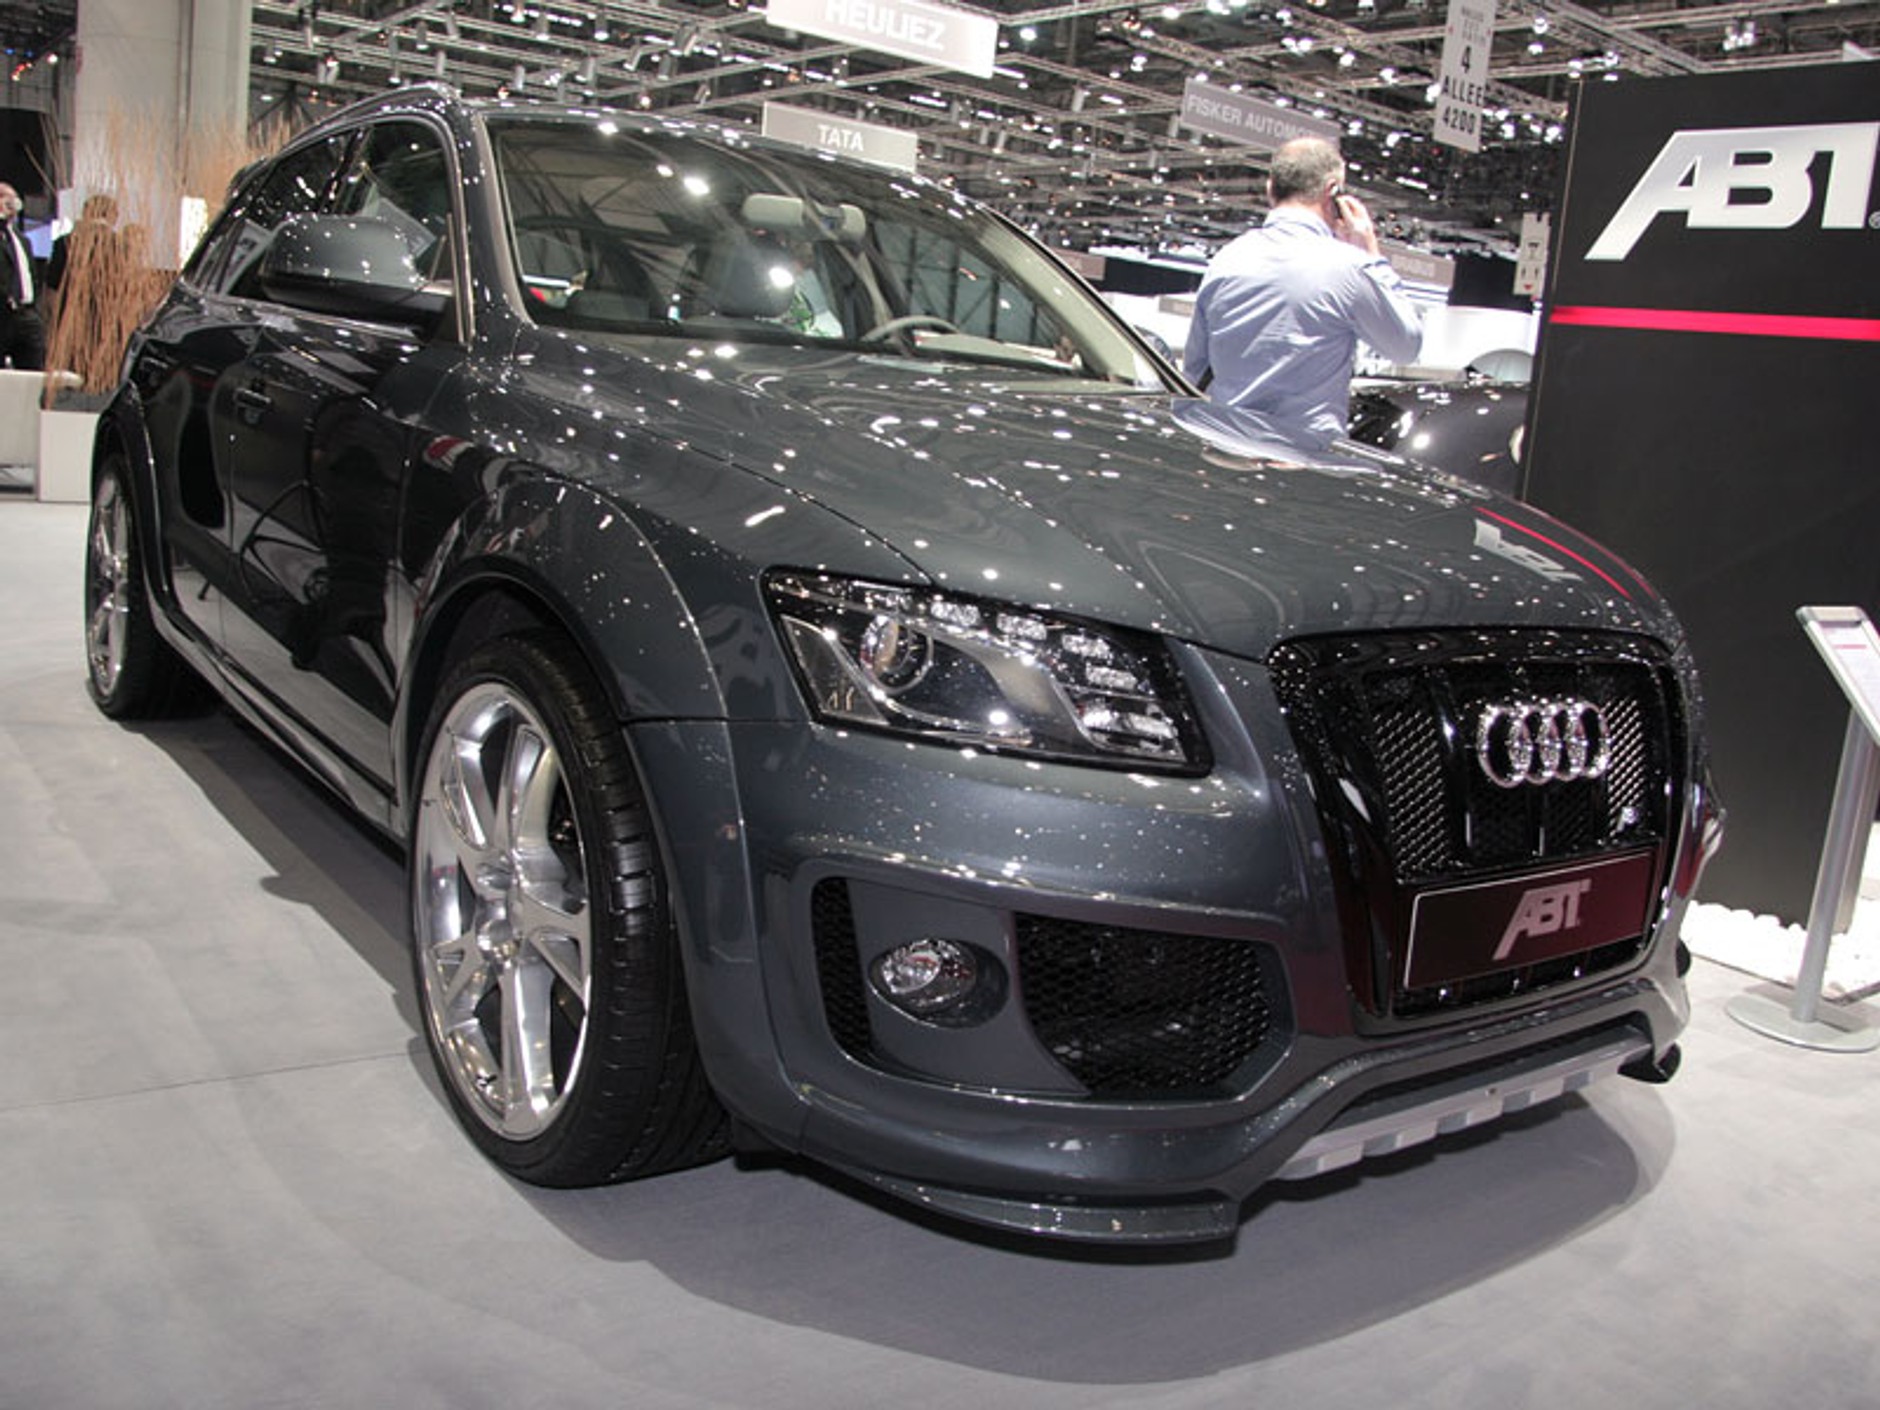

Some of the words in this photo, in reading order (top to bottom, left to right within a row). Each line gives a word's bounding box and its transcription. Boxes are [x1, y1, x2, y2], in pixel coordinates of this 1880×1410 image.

[824, 0, 945, 50] HEULIEZ
[1461, 45, 1471, 74] 4
[1441, 75, 1483, 107] ALLEE
[1186, 94, 1241, 126] FISKER
[1442, 106, 1476, 135] 4200
[816, 123, 864, 152] TATA
[1583, 120, 1880, 261] ABT
[1492, 878, 1592, 961] ABT
